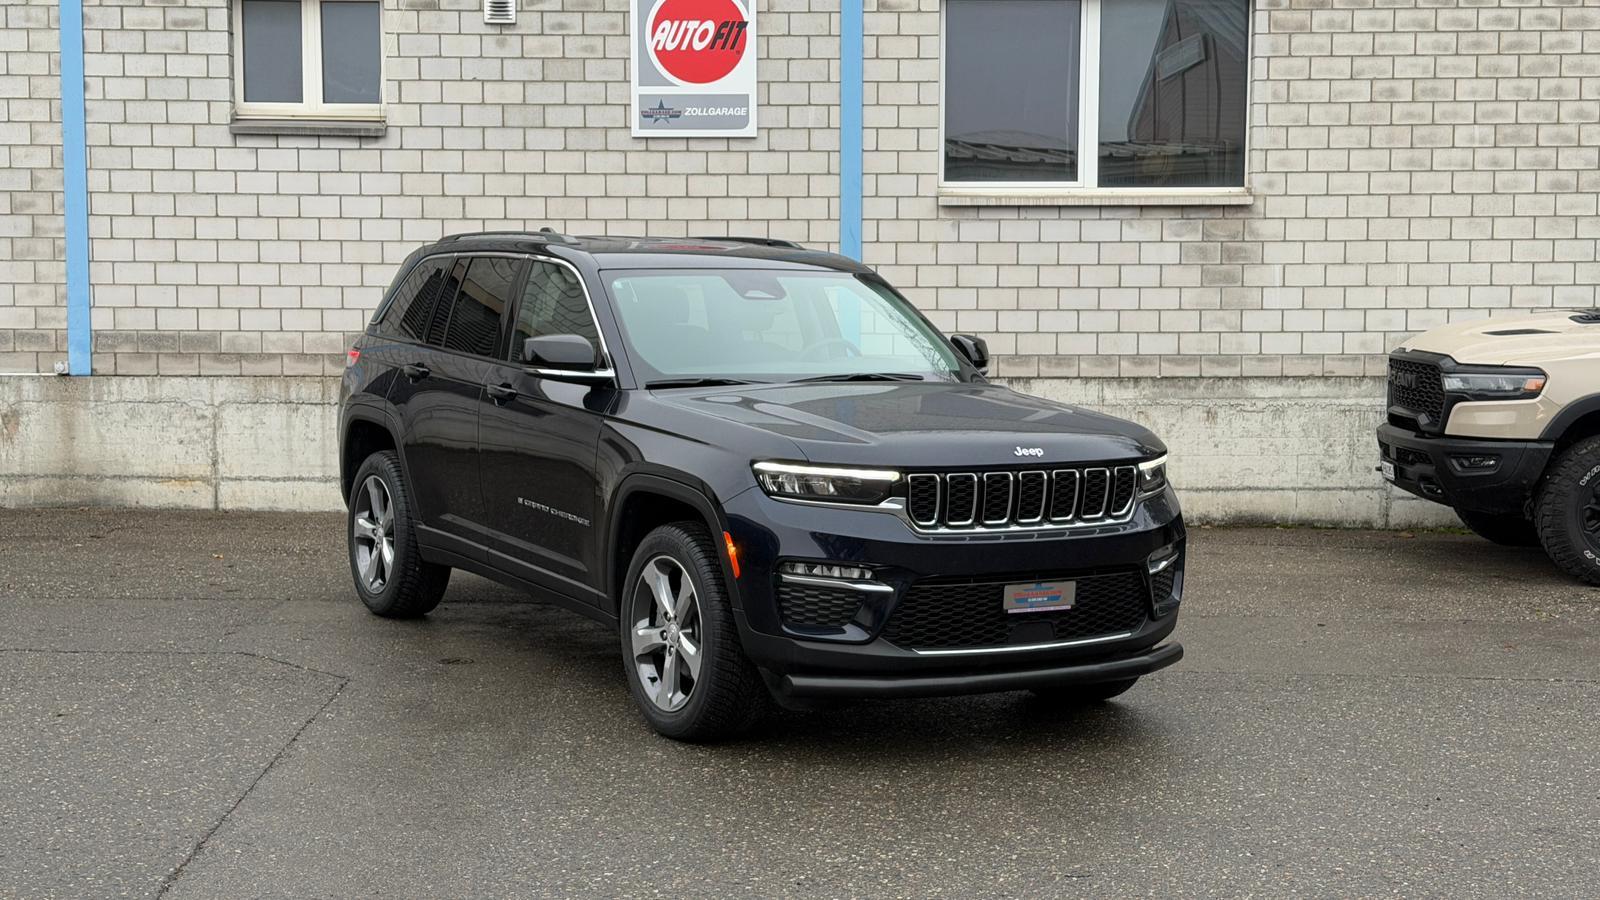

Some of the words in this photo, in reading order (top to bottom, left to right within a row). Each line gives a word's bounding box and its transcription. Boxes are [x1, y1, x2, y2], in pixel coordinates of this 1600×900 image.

[652, 19, 749, 51] AUTOFIT
[684, 107, 748, 116] ZOLLGARAGE
[1014, 446, 1044, 458] Jeep
